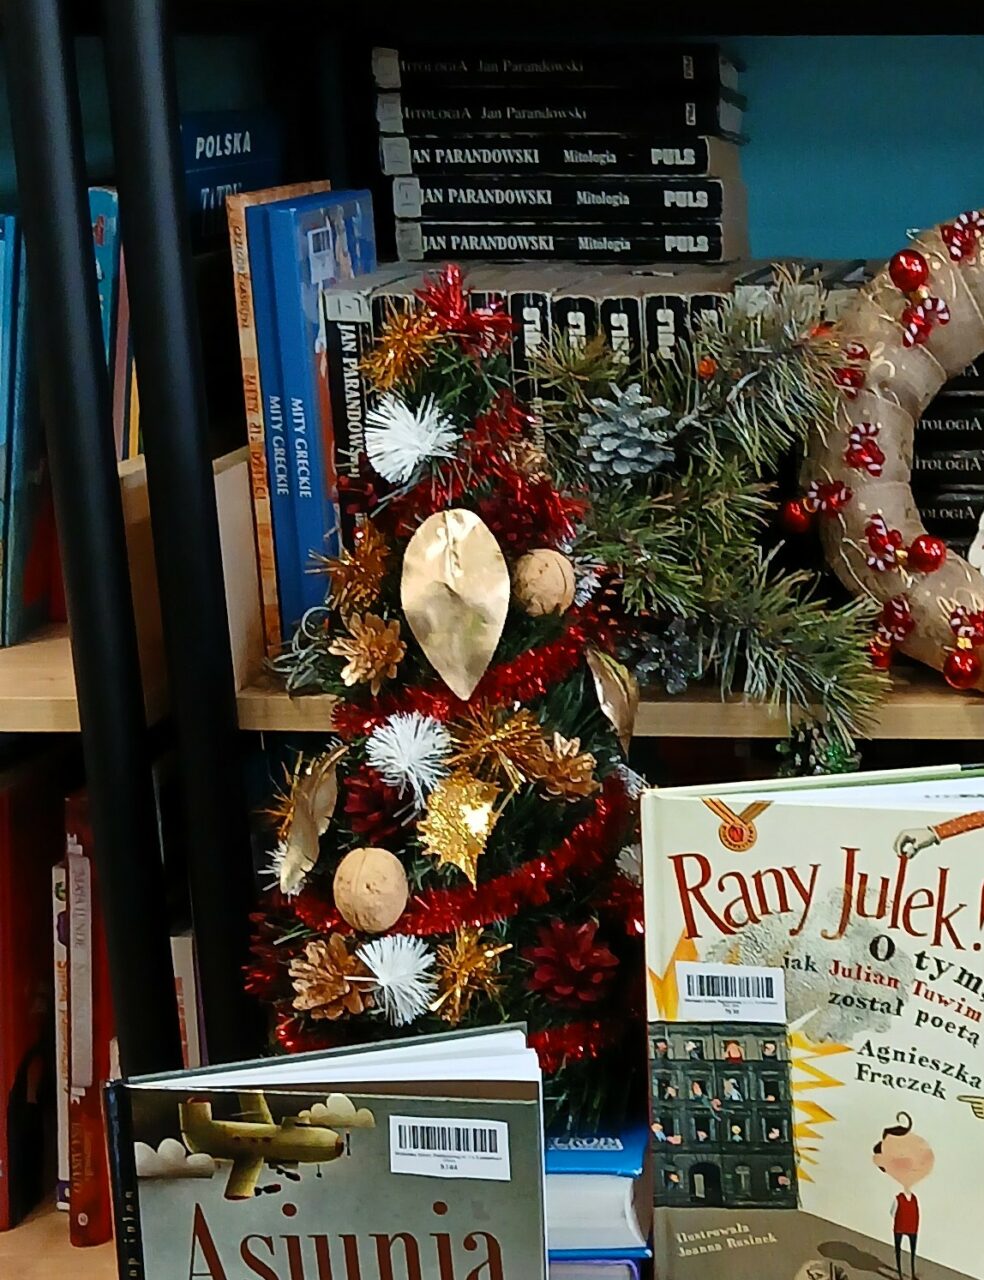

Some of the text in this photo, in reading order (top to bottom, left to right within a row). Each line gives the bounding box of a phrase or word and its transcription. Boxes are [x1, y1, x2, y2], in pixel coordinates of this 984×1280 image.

[477, 59, 584, 73] Jan Parandowski
[481, 106, 587, 120] Jan Parandowski
[194, 130, 252, 159] POLSKA
[436, 148, 696, 165] PARANDOWSKI Mitologia PULS
[448, 188, 552, 205] PARANDOWSKI
[576, 191, 630, 207] Mitologia
[664, 190, 708, 207] PULS
[423, 235, 709, 252] JAN PARANDOWSKI Mitologia PULS
[336, 322, 355, 354] JAN
[268, 395, 289, 495] MITY GRECKIE
[291, 397, 312, 499] MITY GRECKIE
[668, 852, 821, 939] Rany
[869, 934, 896, 962] O
[829, 959, 901, 990] Julian
[911, 978, 984, 1024] Tuwim
[856, 1038, 983, 1090] Agnieszka
[678, 1242, 722, 1258] Joanna
